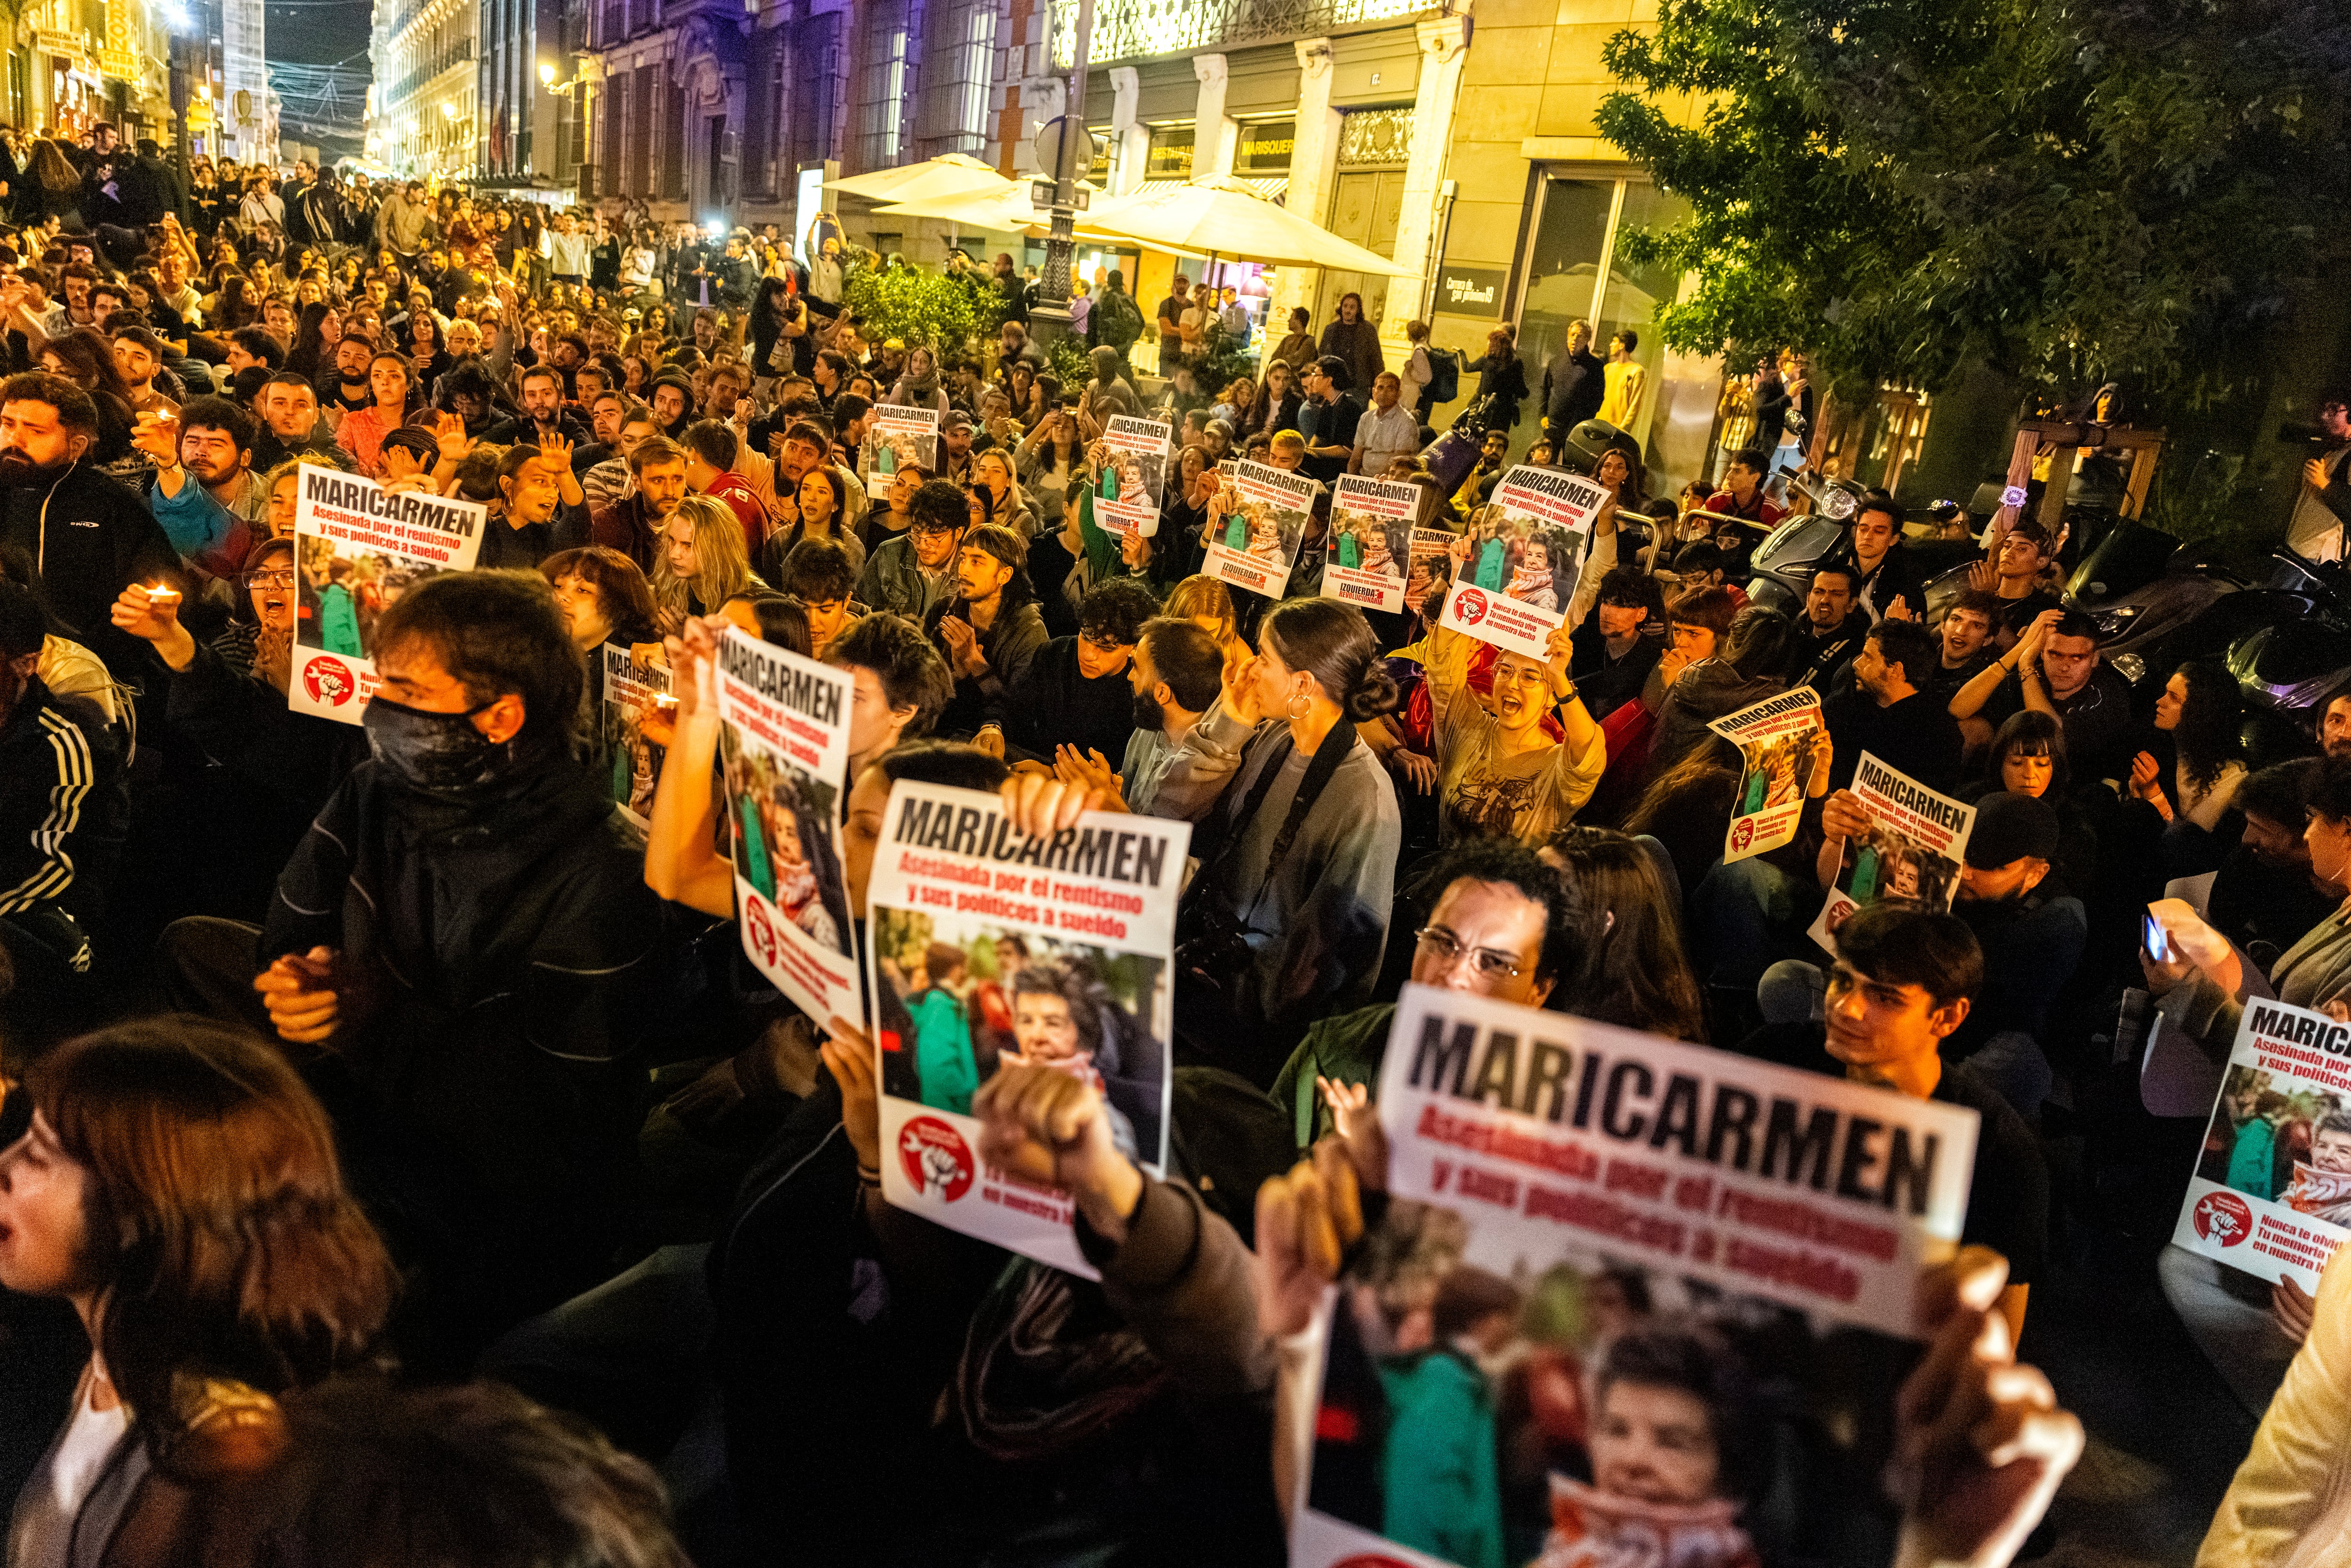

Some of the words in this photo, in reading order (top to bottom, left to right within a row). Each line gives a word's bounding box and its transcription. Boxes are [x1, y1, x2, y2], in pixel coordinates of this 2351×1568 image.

[1152, 145, 1194, 160] RESTAURAN
[1241, 139, 1294, 156] MARISQUER
[1484, 286, 1494, 303] 19
[876, 406, 935, 423] MARICARMEN
[1109, 418, 1168, 439] ARICARMEN
[1237, 462, 1314, 497] MARICARMEN
[1238, 476, 1265, 490] Asesinada
[1281, 490, 1306, 504] rentismo
[1340, 477, 1418, 503] MARICARMEN
[1504, 469, 1602, 511] MARICARMEN
[307, 472, 476, 538] MARICARMEN
[1281, 498, 1301, 509] sueldo
[1341, 492, 1369, 503] Asesinada
[1385, 500, 1410, 510] rentismo
[1386, 508, 1405, 517] sueldo
[1502, 485, 1534, 501] Asesinada
[1533, 494, 1546, 504] por
[1546, 497, 1553, 507] el
[1552, 501, 1585, 518] rentismo
[1505, 497, 1518, 507] sus
[1546, 510, 1552, 518] a
[1551, 512, 1575, 527] sueldo
[312, 504, 371, 530] Asesinada
[373, 520, 392, 535] por
[394, 526, 405, 536] el
[407, 528, 461, 550] rentismo
[1105, 514, 1131, 527] IZQUIERDA
[319, 522, 326, 535] y
[328, 524, 348, 539] sus
[401, 543, 408, 553] a
[410, 544, 450, 563] sueldo
[1220, 569, 1265, 590] REVOLUCIONARIA
[1222, 562, 1258, 581] IZQUIERDA
[1339, 591, 1383, 606] REVOLUCIONARIA
[1340, 583, 1375, 597] IZQUIERDA
[1491, 601, 1511, 615] Nunca
[1511, 608, 1518, 617] te
[1518, 610, 1556, 630] olvidaremos.
[1496, 613, 1524, 628] memoria
[1524, 622, 1537, 632] vive
[1493, 622, 1518, 636] nuestra
[1518, 629, 1536, 642] lucha
[1715, 690, 1817, 733] MARICARMEN
[1770, 715, 1783, 725] por
[1859, 759, 1967, 835] MARICARMEN
[1858, 785, 1894, 813] Asesinada
[1894, 805, 1909, 820] por
[1908, 813, 1917, 825] el
[1917, 818, 1954, 843] rentismo
[1913, 827, 1919, 837] a
[1919, 831, 1947, 852] sueldo
[994, 871, 1027, 893] por
[1030, 875, 1049, 897] el
[1052, 881, 1144, 916] rentismo
[907, 883, 916, 904] y
[1042, 908, 1055, 925] a
[1059, 909, 1128, 939] sueldo
[2250, 1005, 2351, 1058] MARIC
[2253, 1036, 2324, 1066] Asesinada
[2324, 1058, 2351, 1074] por
[2258, 1054, 2267, 1067] y
[2267, 1057, 2292, 1073] sus
[1409, 1013, 1940, 1219] MARICARMEN
[2260, 1213, 2297, 1236] Nunca
[2253, 1240, 2267, 1253] en
[2268, 1246, 2314, 1272] nuestra
[2258, 1227, 2271, 1241] Tu
[2272, 1234, 2326, 1260] memoria
